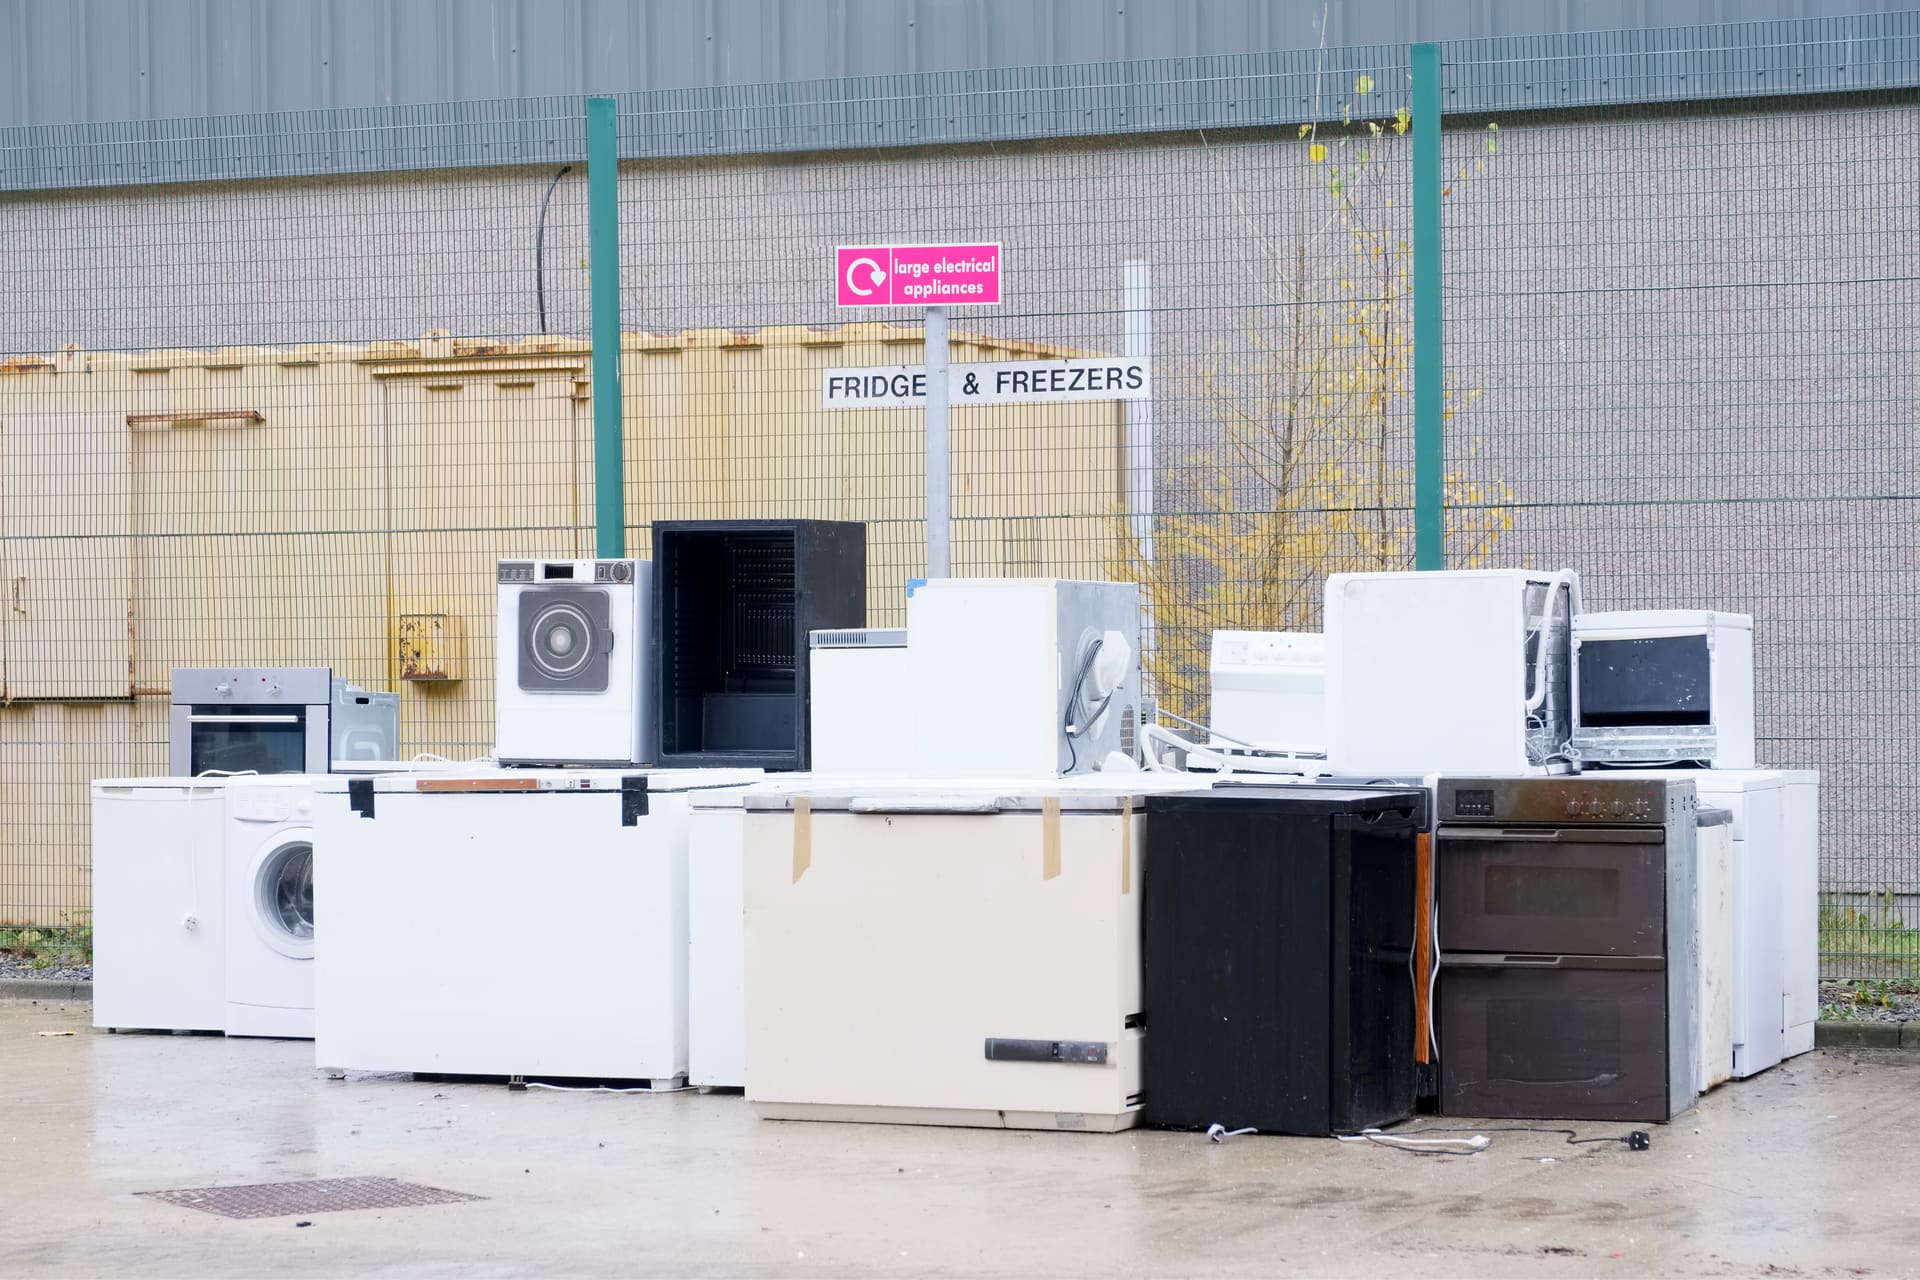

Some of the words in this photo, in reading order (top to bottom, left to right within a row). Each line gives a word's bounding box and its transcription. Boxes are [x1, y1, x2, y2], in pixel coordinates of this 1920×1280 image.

[894, 257, 930, 278] large
[933, 255, 995, 274] electrical
[903, 279, 984, 299] appliances
[828, 374, 927, 399] FRIDGE
[962, 372, 980, 395] &
[996, 365, 1144, 394] FREEZERS
